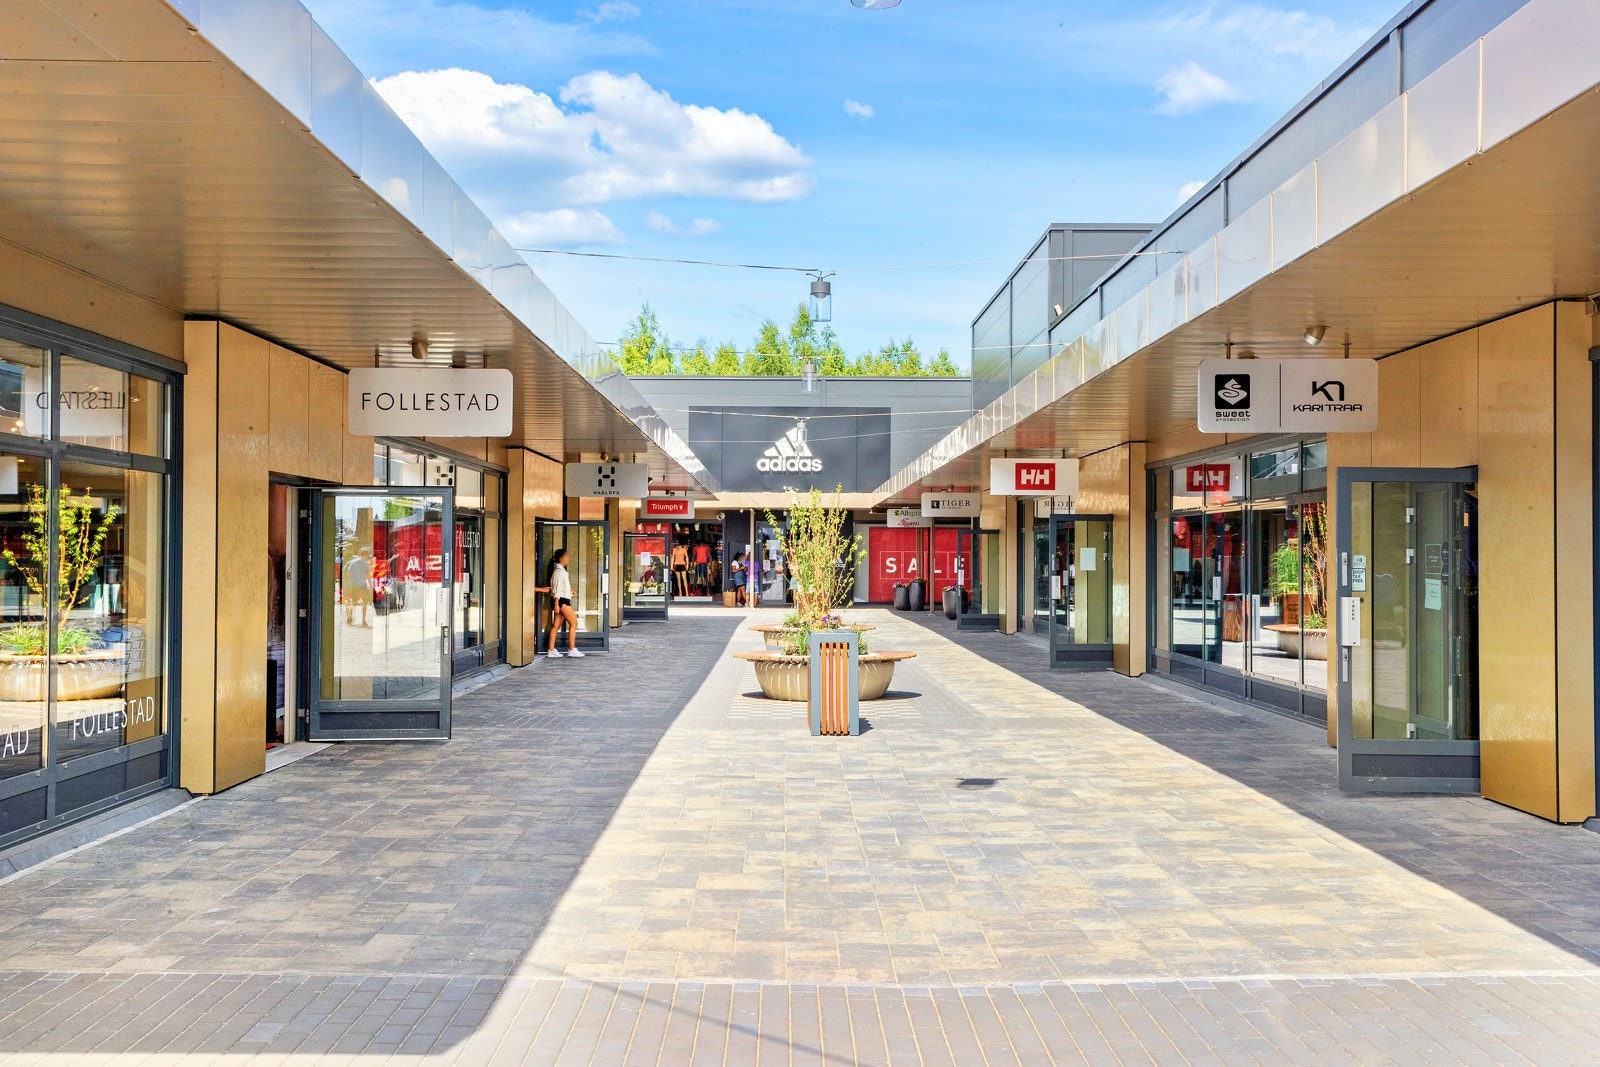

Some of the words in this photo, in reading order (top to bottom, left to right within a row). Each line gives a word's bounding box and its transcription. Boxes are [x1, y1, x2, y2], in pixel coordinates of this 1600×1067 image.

[362, 392, 499, 411] FOLLESTAD
[1293, 404, 1324, 412] KARI
[1325, 404, 1363, 412] TRAA
[1215, 410, 1250, 418] sweet
[756, 455, 823, 472] adidas
[651, 503, 678, 512] Triumph
[941, 499, 971, 507] TIGER
[900, 509, 922, 518] Allspo
[72, 696, 155, 741] FOLLESTAD
